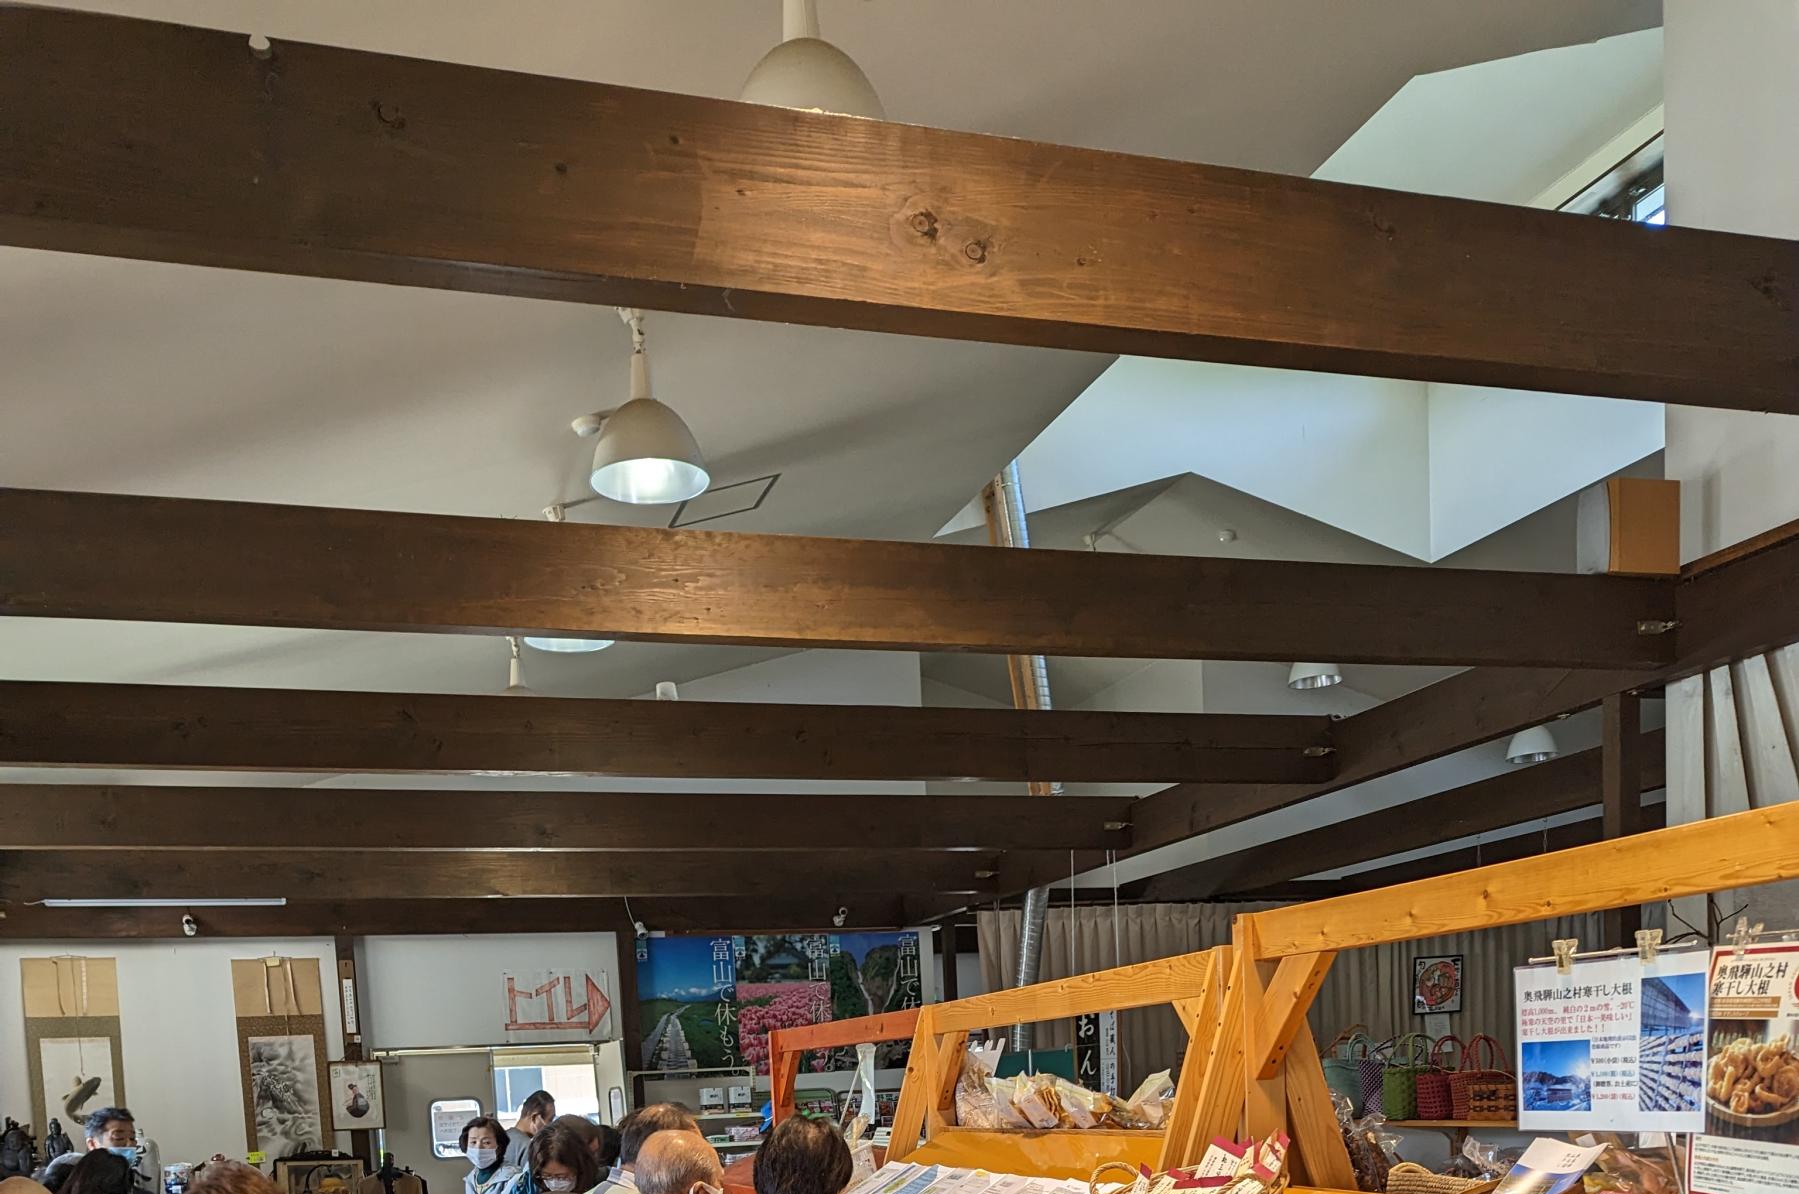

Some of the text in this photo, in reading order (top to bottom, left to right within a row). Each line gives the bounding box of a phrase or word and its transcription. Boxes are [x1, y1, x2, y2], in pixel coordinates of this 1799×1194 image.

[506, 975, 588, 1024] トイレ
[1712, 980, 1770, 996] 寒干し大根
